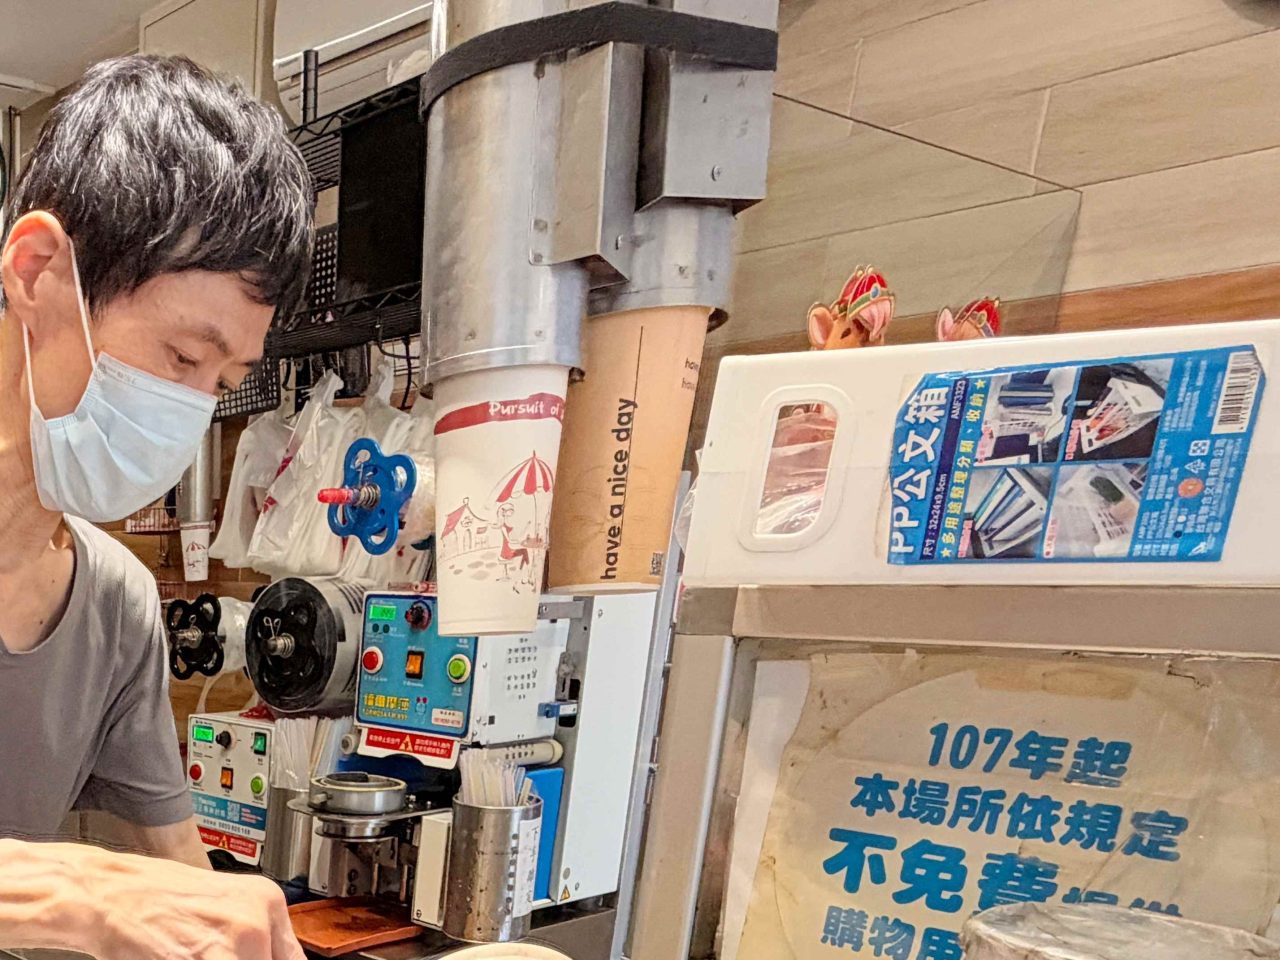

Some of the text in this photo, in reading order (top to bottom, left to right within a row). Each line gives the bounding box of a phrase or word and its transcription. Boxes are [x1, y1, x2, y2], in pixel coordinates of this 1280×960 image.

[489, 401, 544, 416] Pursuit
[600, 398, 638, 580] have a nice day
[891, 387, 949, 553] PP公文箱
[928, 722, 1133, 788] 107年起
[851, 773, 1189, 862] 本場所依規定
[822, 827, 1184, 918] 不免費
